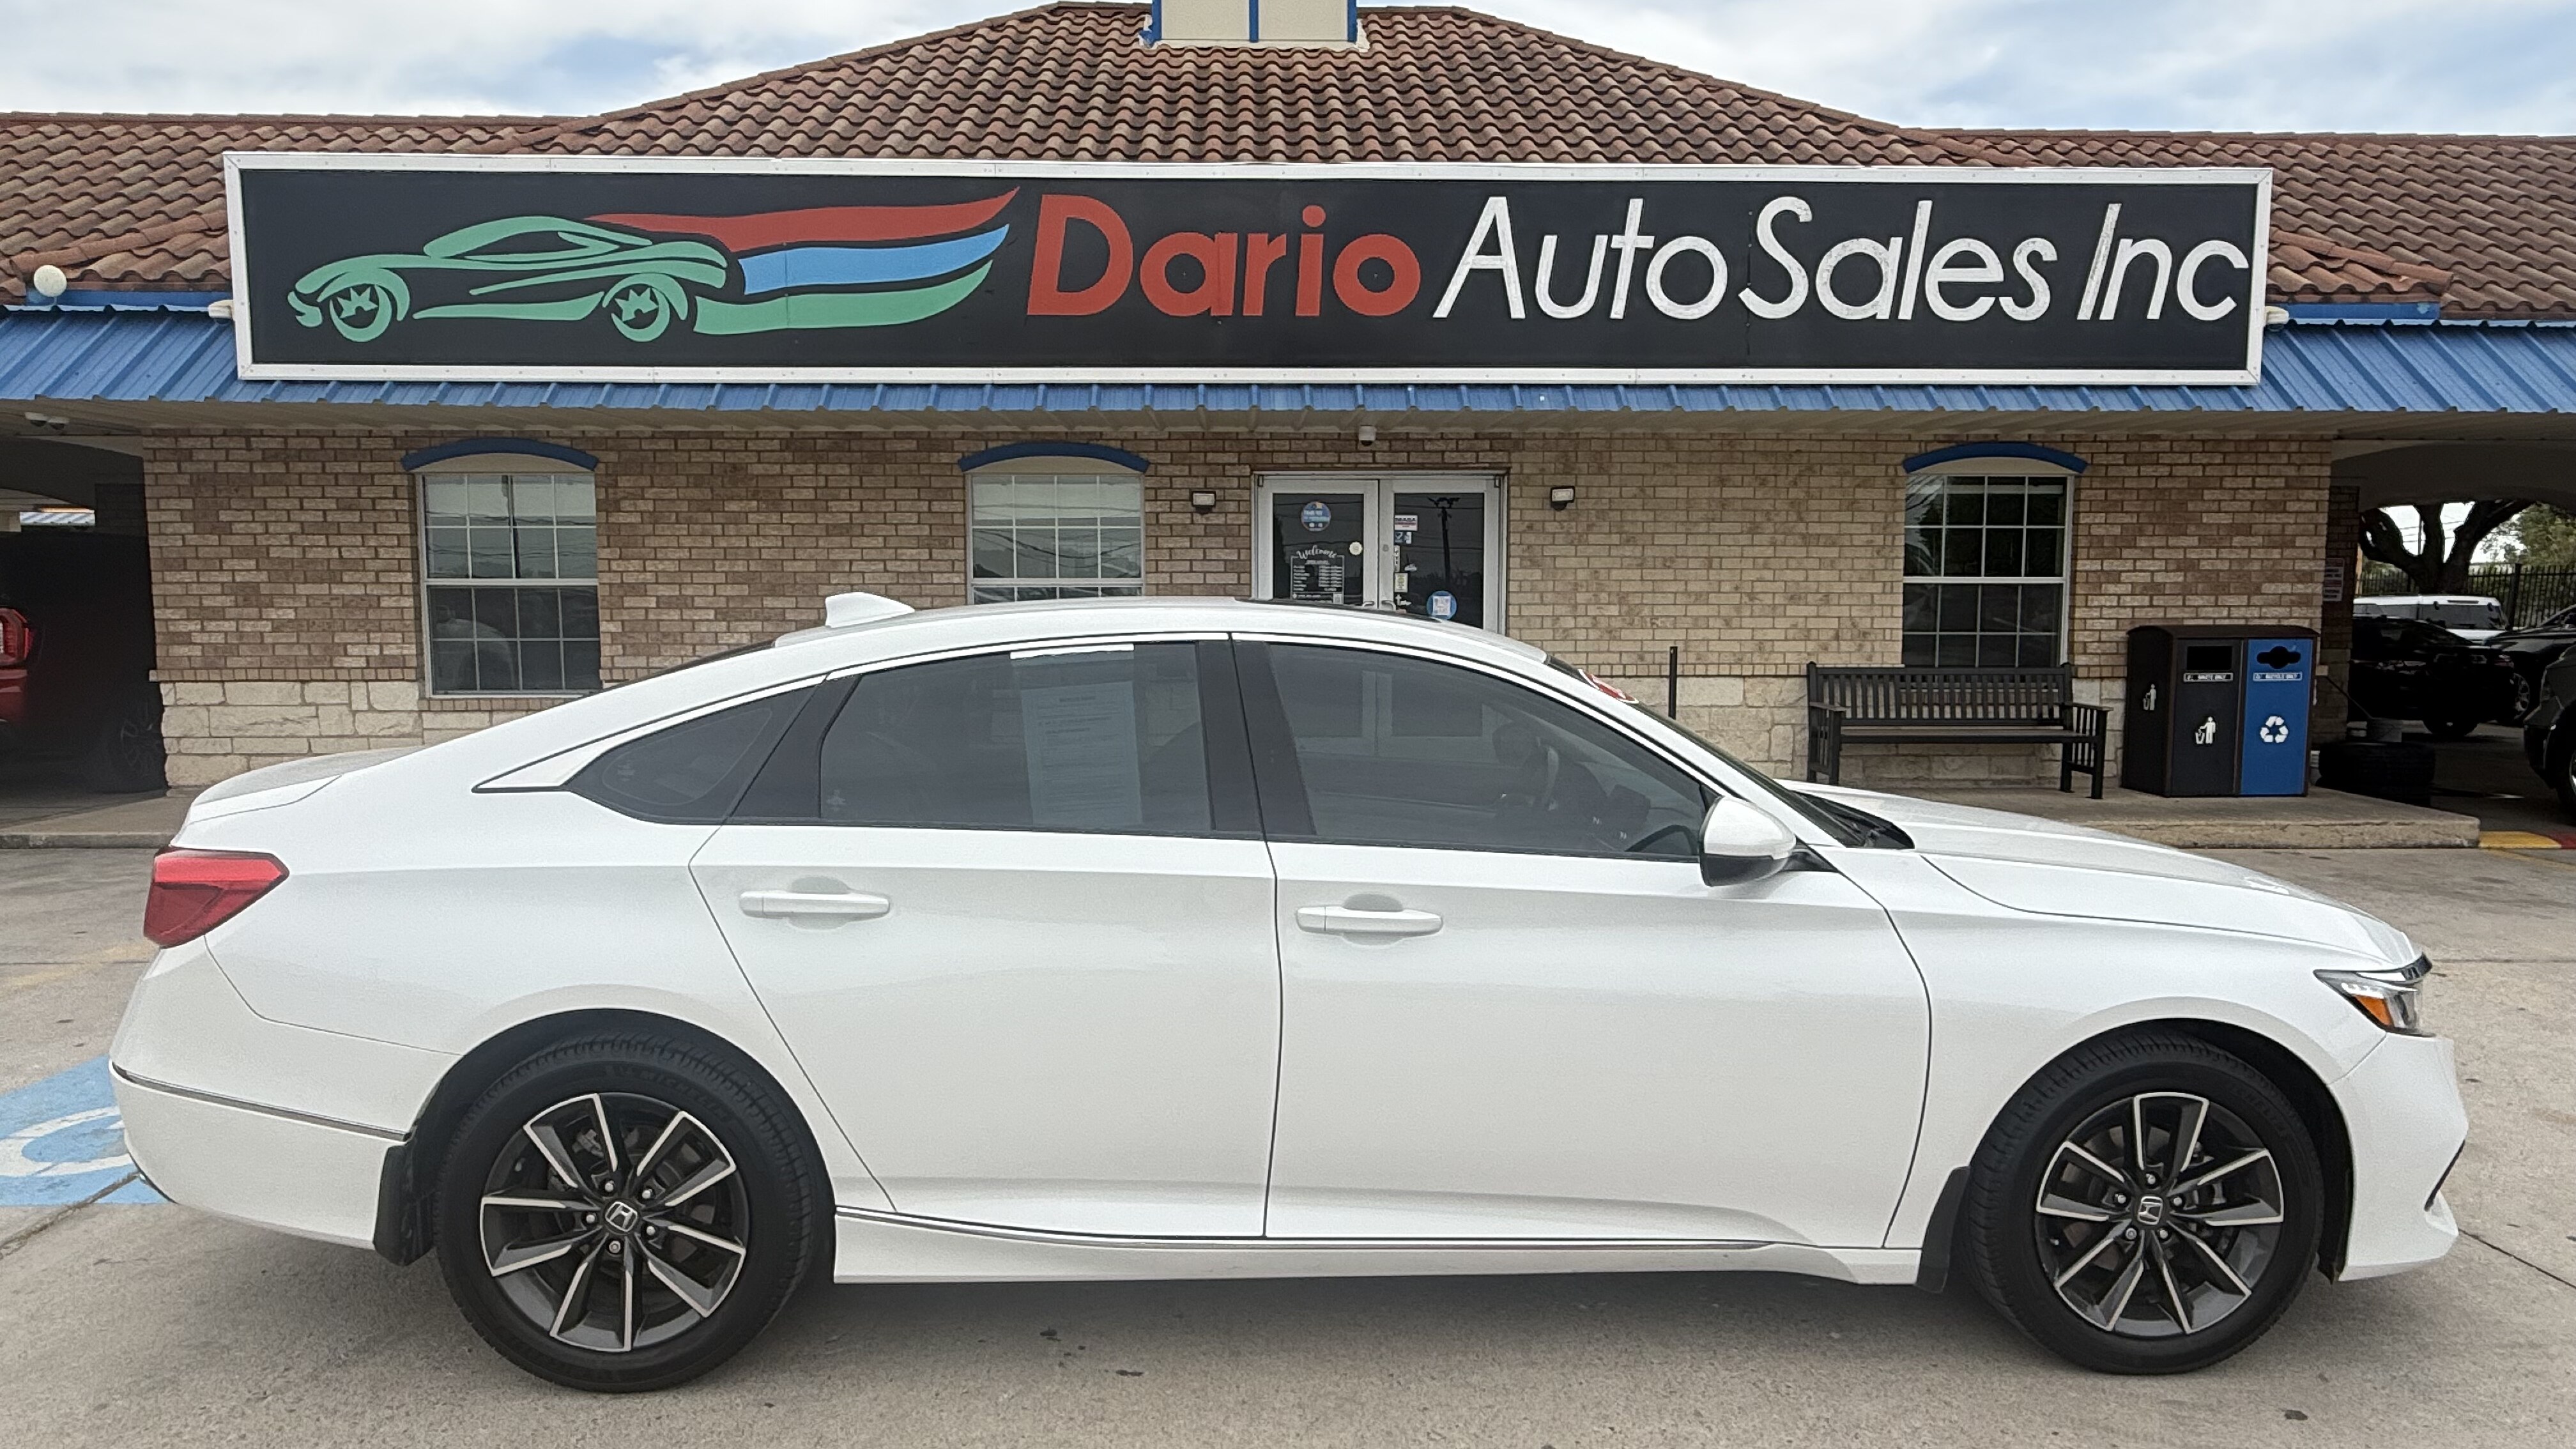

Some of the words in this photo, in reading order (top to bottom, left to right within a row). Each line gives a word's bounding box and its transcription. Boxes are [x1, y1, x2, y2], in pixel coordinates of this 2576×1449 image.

[1027, 195, 1420, 316] Dario
[1432, 196, 1728, 319] Auto
[1738, 196, 2057, 321] Sales
[2076, 203, 2249, 321] Inc
